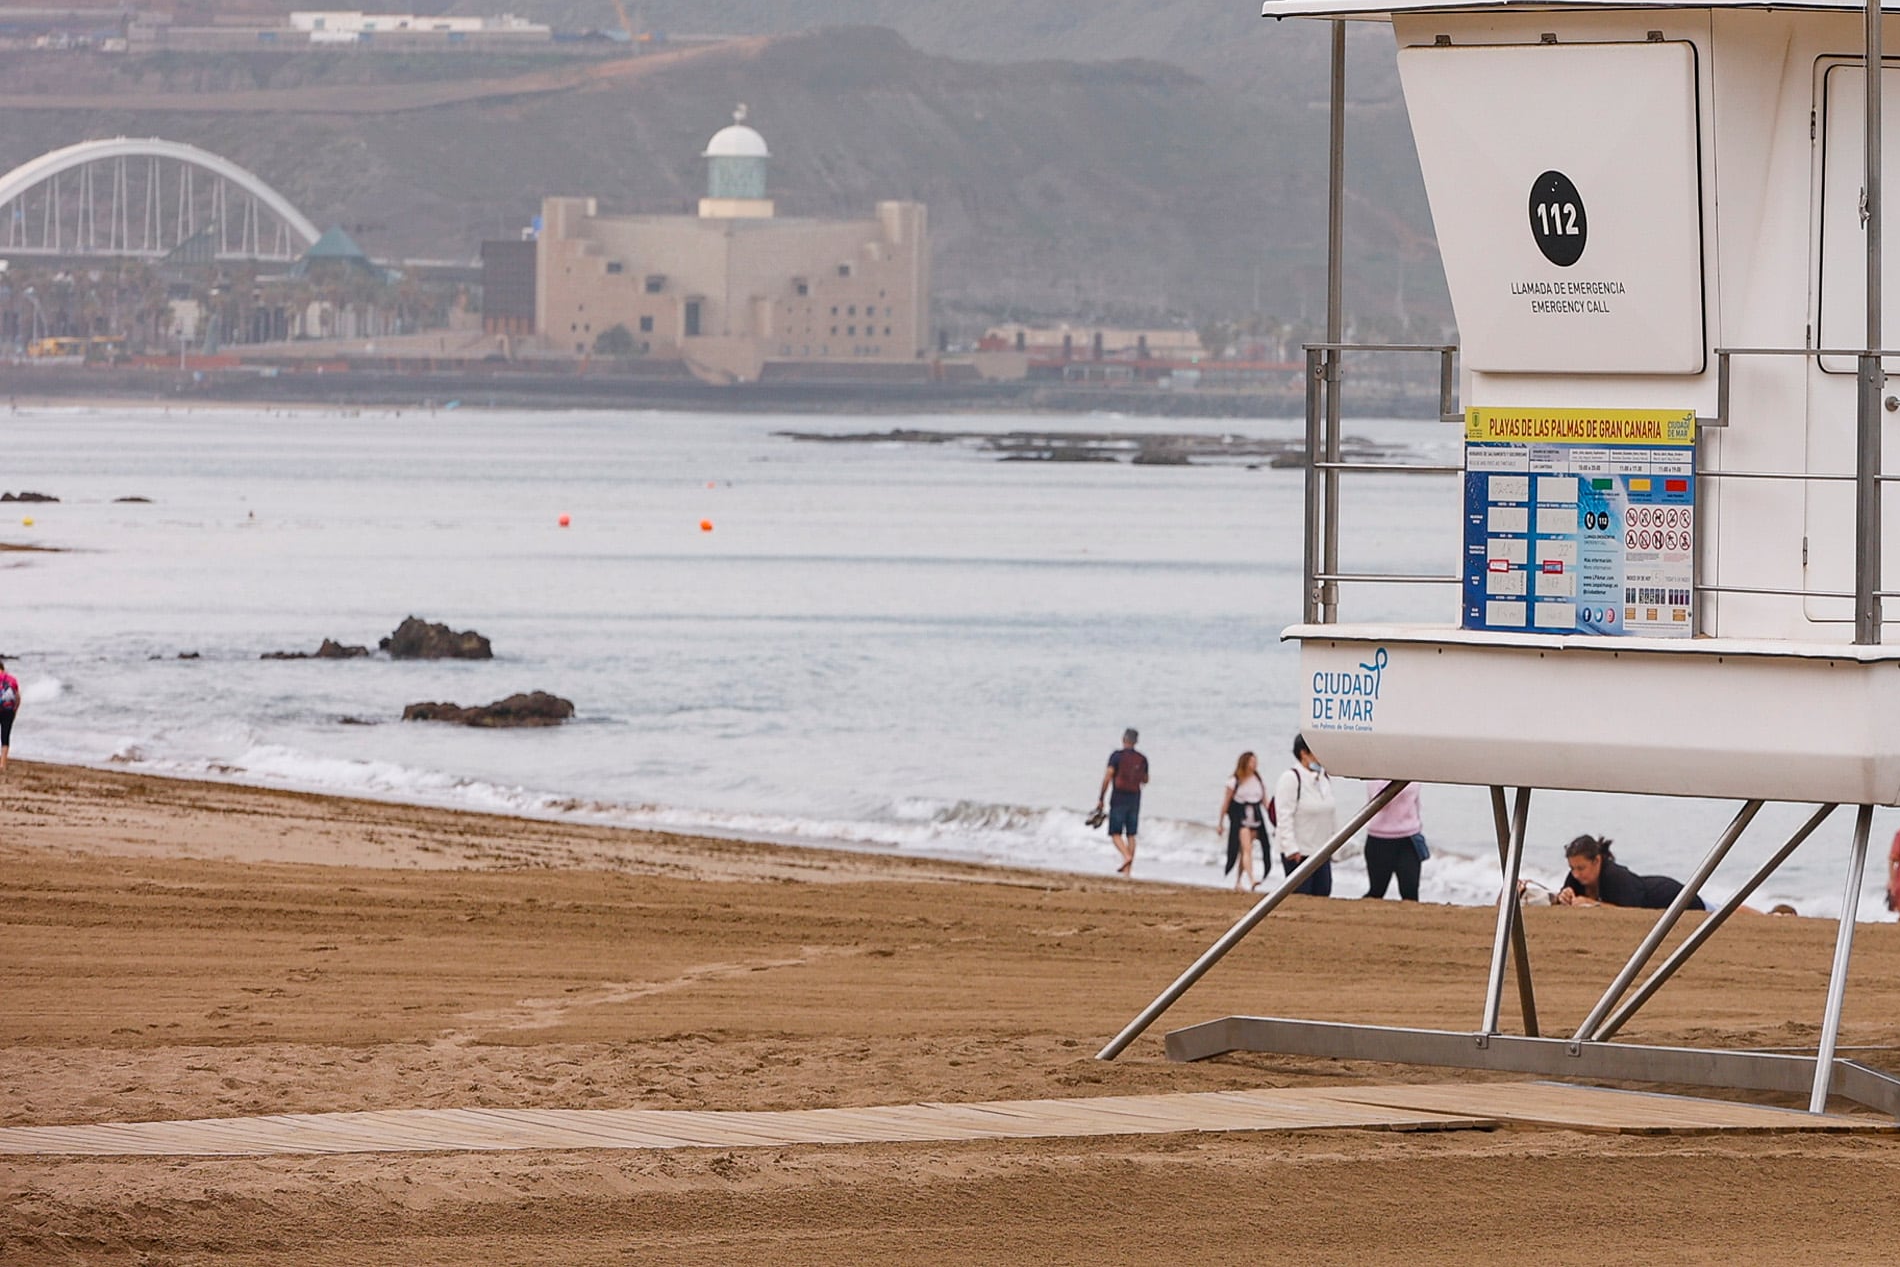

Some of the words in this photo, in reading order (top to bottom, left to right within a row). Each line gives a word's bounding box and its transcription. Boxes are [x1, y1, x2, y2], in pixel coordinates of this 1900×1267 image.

[1537, 202, 1580, 236] 112
[1511, 282, 1552, 295] LLAMADA
[1554, 282, 1566, 295] DE
[1568, 282, 1626, 295] EMERGENCIA
[1531, 300, 1585, 313] EMERGENCY
[1586, 300, 1610, 313] CALL
[1489, 418, 1520, 436] PLAYAS
[1521, 418, 1532, 437] DE
[1534, 419, 1549, 437] LAS
[1551, 419, 1584, 438] PALMAS
[1586, 419, 1598, 438] DE
[1599, 420, 1623, 438] GRAN
[1624, 420, 1662, 439] CANARIA
[1313, 672, 1374, 696] CIUDAD
[1313, 698, 1334, 719] DE
[1338, 699, 1373, 722] MAR
